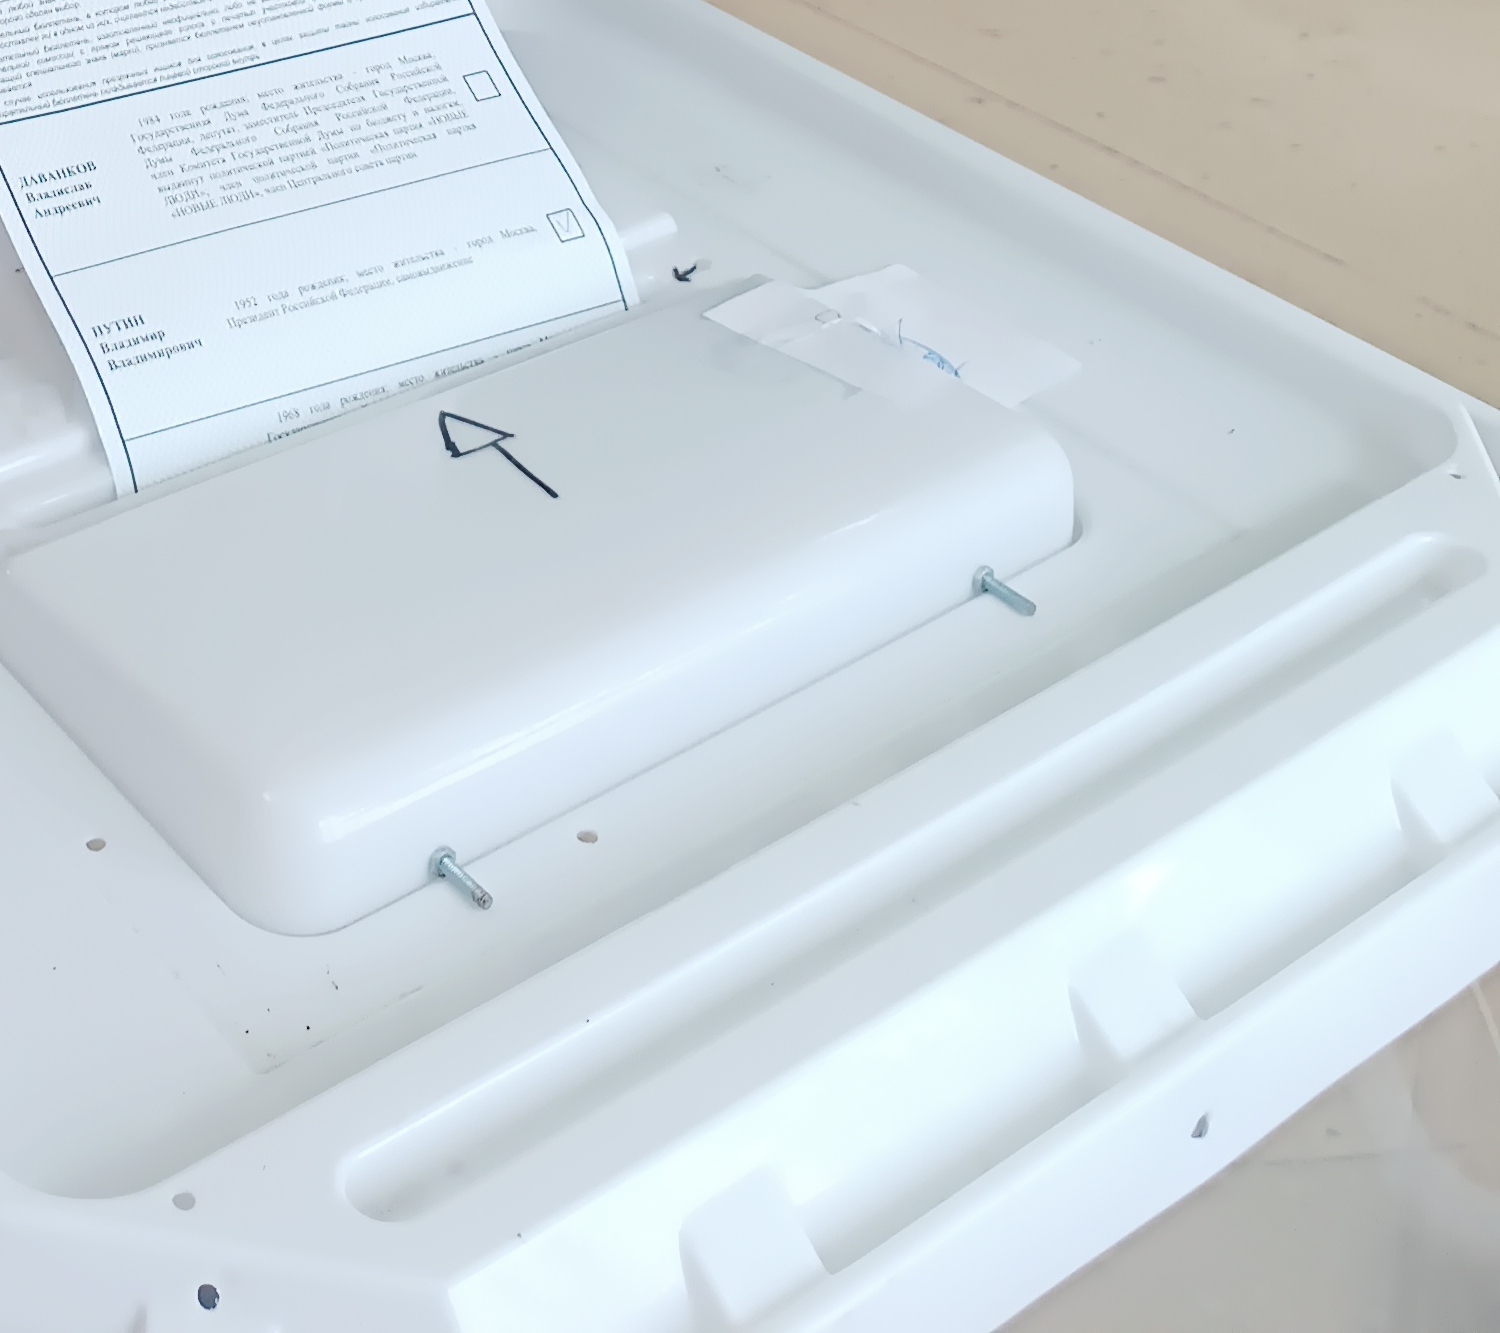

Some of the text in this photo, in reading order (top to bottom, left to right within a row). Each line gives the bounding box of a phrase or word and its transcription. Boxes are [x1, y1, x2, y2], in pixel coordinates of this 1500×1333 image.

[20, 161, 96, 189] ДАВАНКОВ
[26, 182, 92, 203] Владислав
[35, 196, 100, 219] Андреевич
[92, 315, 144, 338] ПУТИН
[100, 331, 165, 354] Владимир
[107, 339, 202, 371] Владимирович
